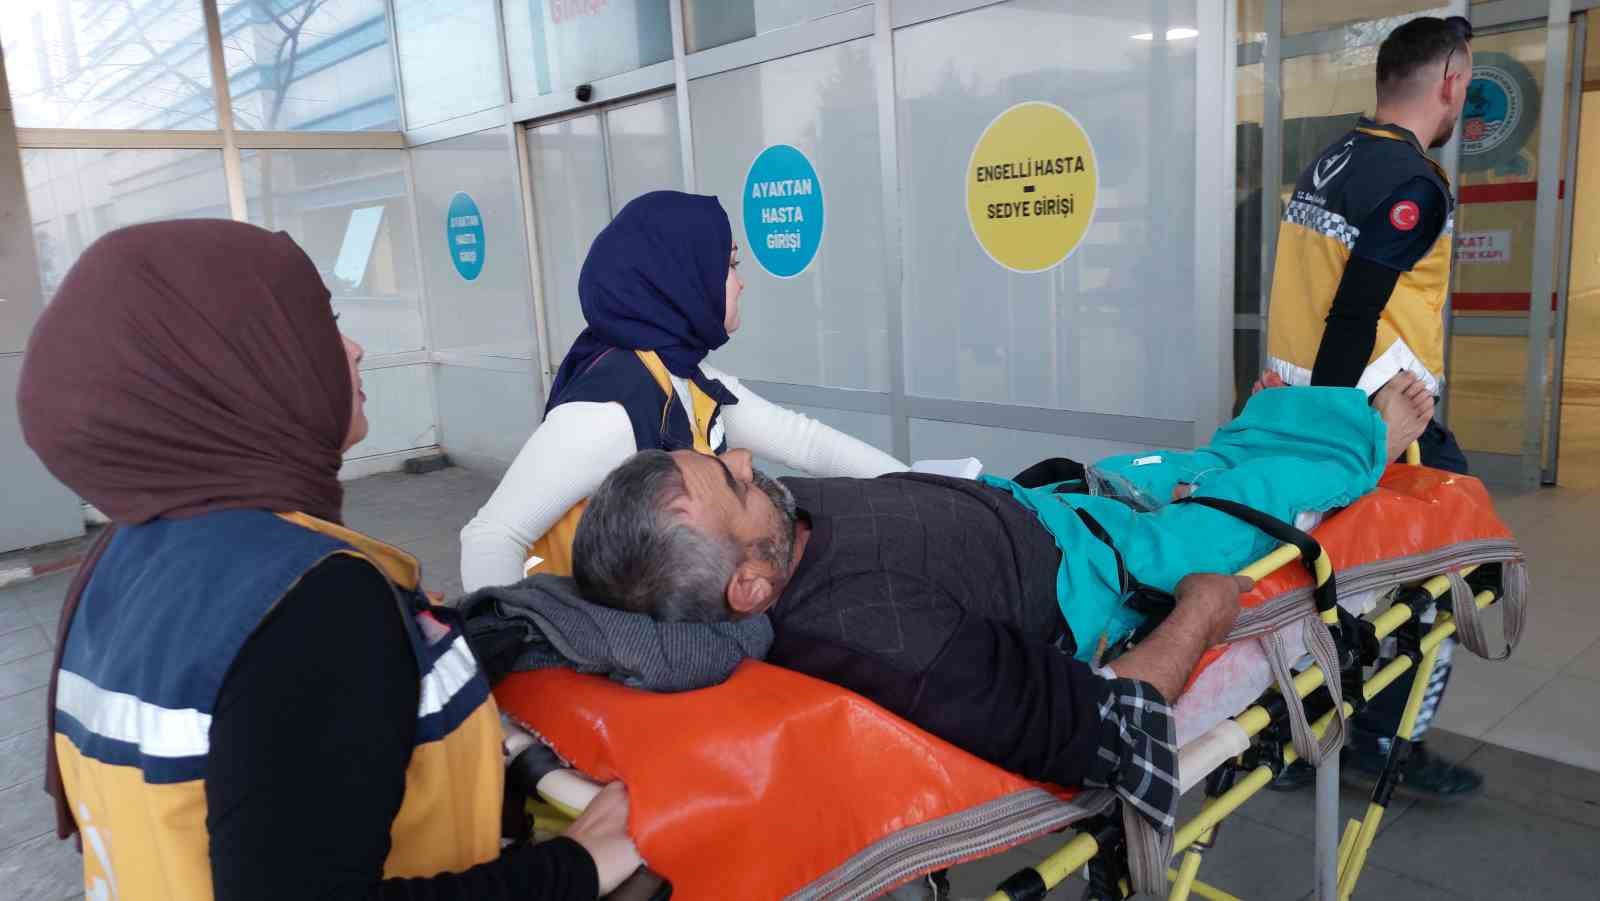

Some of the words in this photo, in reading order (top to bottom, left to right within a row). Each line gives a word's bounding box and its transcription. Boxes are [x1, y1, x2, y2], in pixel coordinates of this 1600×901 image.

[976, 158, 1032, 182] ENGELLİ
[1034, 155, 1085, 176] HASTA
[752, 179, 812, 199] AYAKTAN
[761, 206, 804, 223] HASTA
[987, 201, 1031, 219] SEDYE
[1033, 193, 1074, 218] GİRİŞİ
[766, 229, 801, 252] GİRİŞİ
